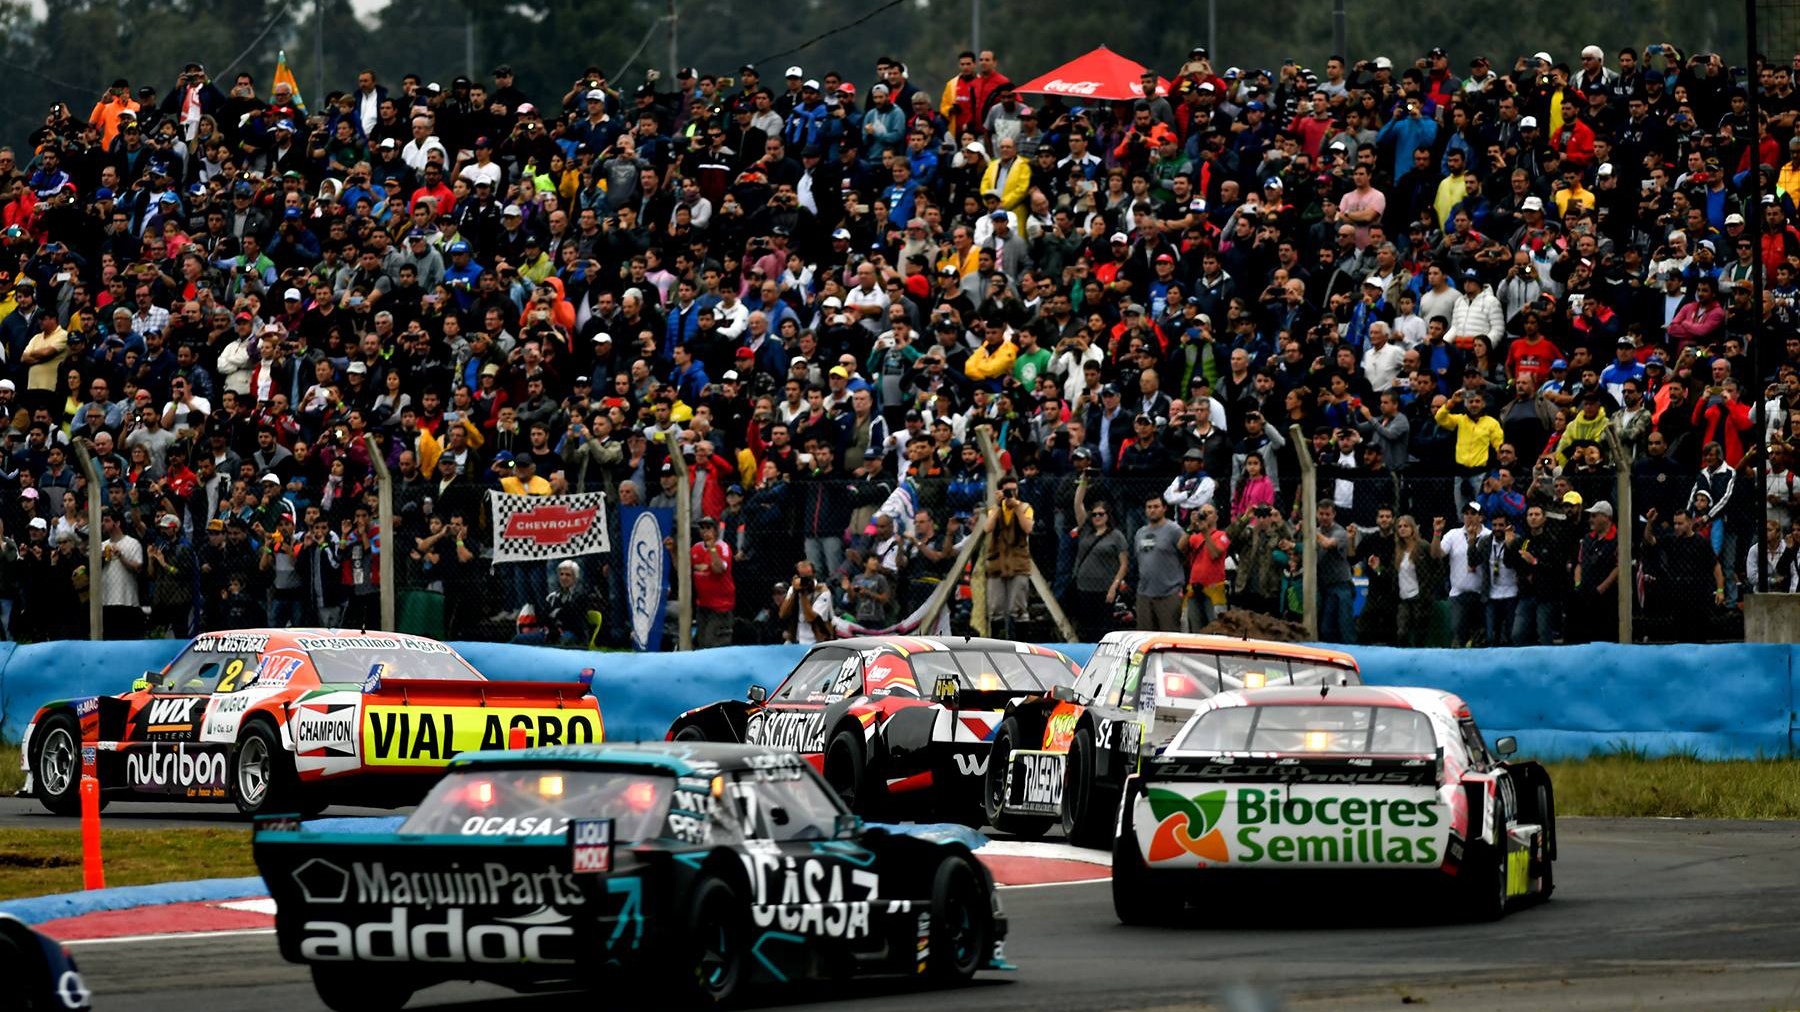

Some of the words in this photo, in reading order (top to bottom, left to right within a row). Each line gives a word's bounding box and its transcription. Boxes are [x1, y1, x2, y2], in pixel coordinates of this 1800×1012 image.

[516, 517, 589, 530] CHEVROLET
[637, 540, 657, 618] Ford
[298, 637, 396, 650] Pergamino
[402, 637, 449, 652] Agro
[216, 659, 244, 692] 2
[148, 697, 200, 724] WIX
[146, 732, 193, 741] FILTERS
[299, 720, 352, 742] CHAMPION
[369, 712, 464, 760] VIAL
[761, 713, 826, 752] SCIENZA
[126, 742, 227, 787] nutribon
[1237, 788, 1439, 827] Bioceres
[573, 848, 610, 870] MOLY
[1236, 827, 1438, 864] Semillas
[352, 862, 586, 910] MaquinParts
[300, 906, 576, 964] addoc
